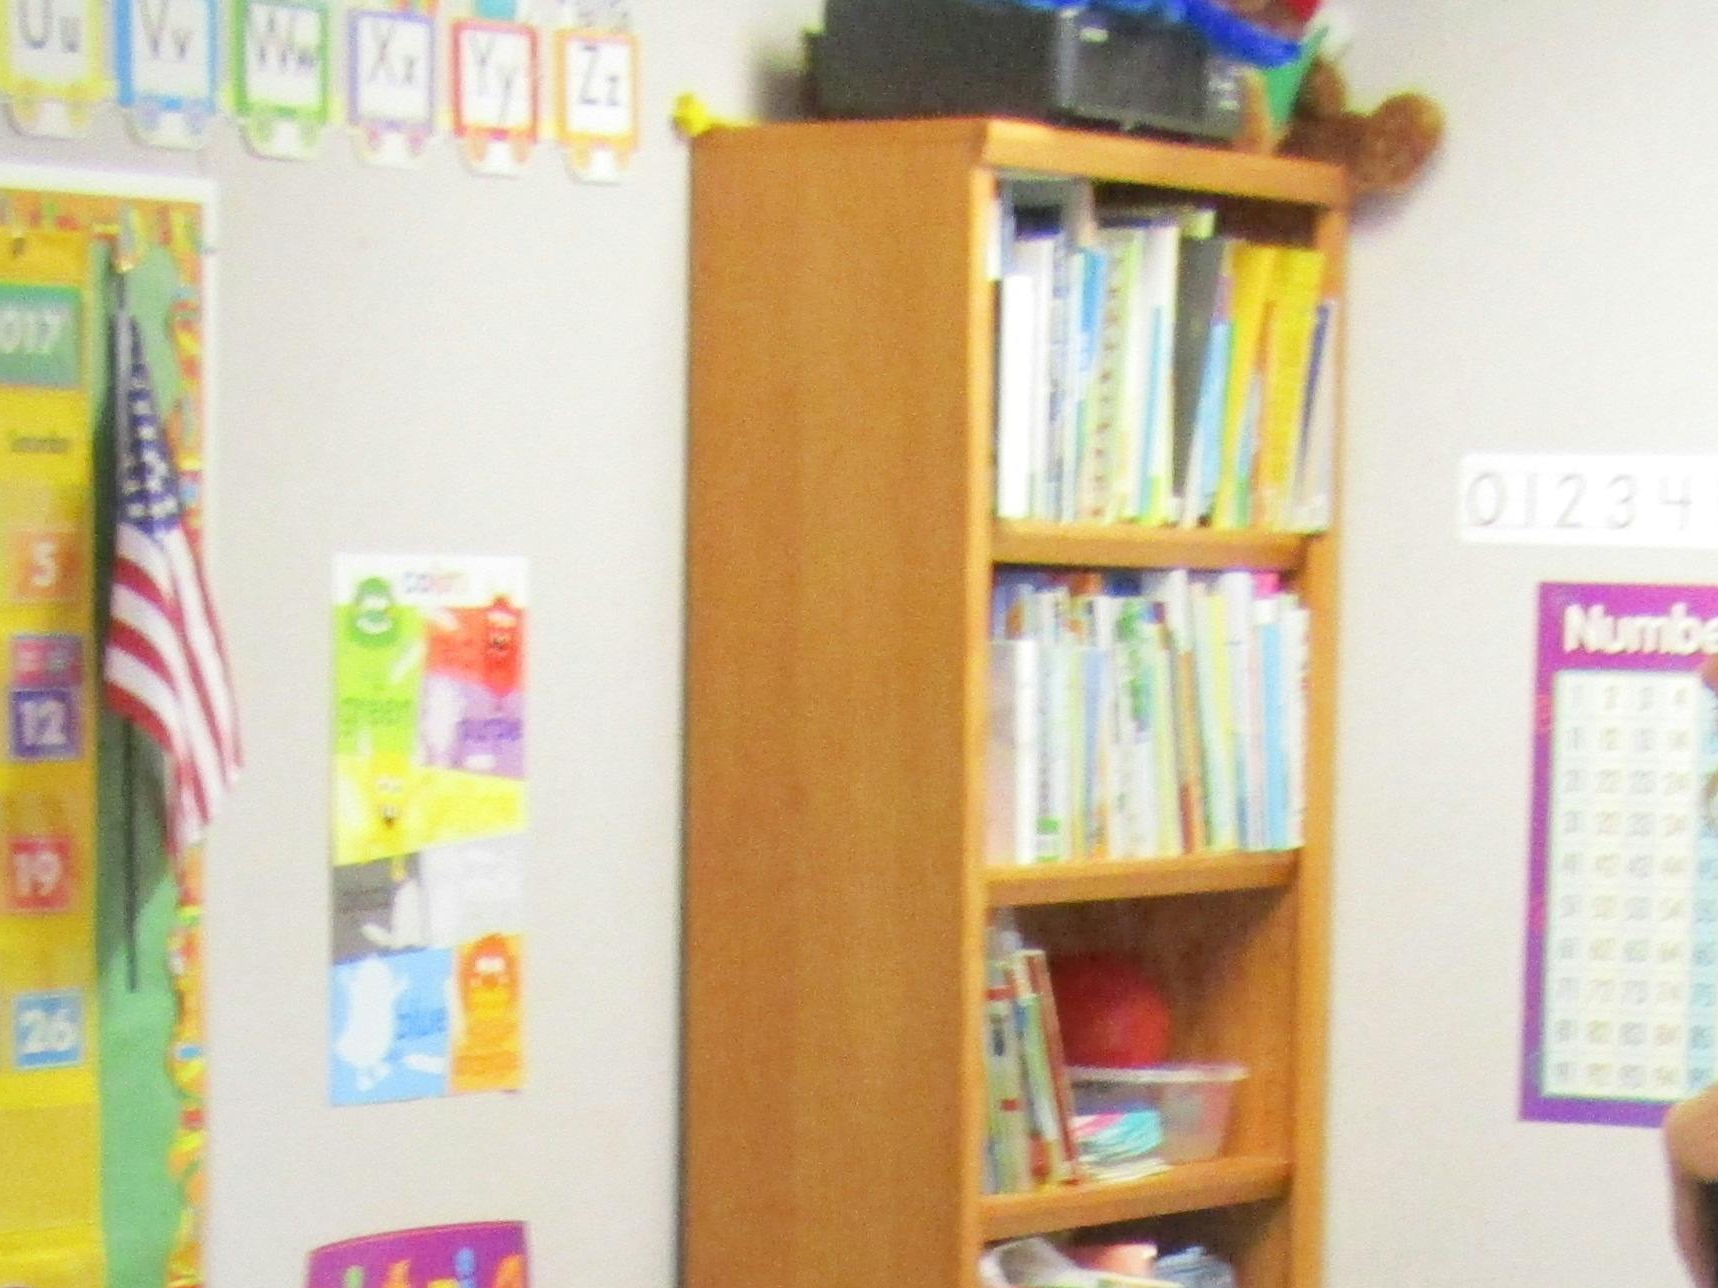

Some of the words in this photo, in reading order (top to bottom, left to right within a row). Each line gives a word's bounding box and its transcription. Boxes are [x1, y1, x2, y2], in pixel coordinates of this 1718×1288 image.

[254, 8, 316, 73] Ww
[366, 22, 417, 86] Xx
[470, 32, 517, 124] Yy
[582, 43, 621, 106] Zz
[31, 540, 58, 588] 5
[19, 700, 67, 748] 12
[13, 852, 60, 896] 19
[21, 1006, 78, 1055] 26
